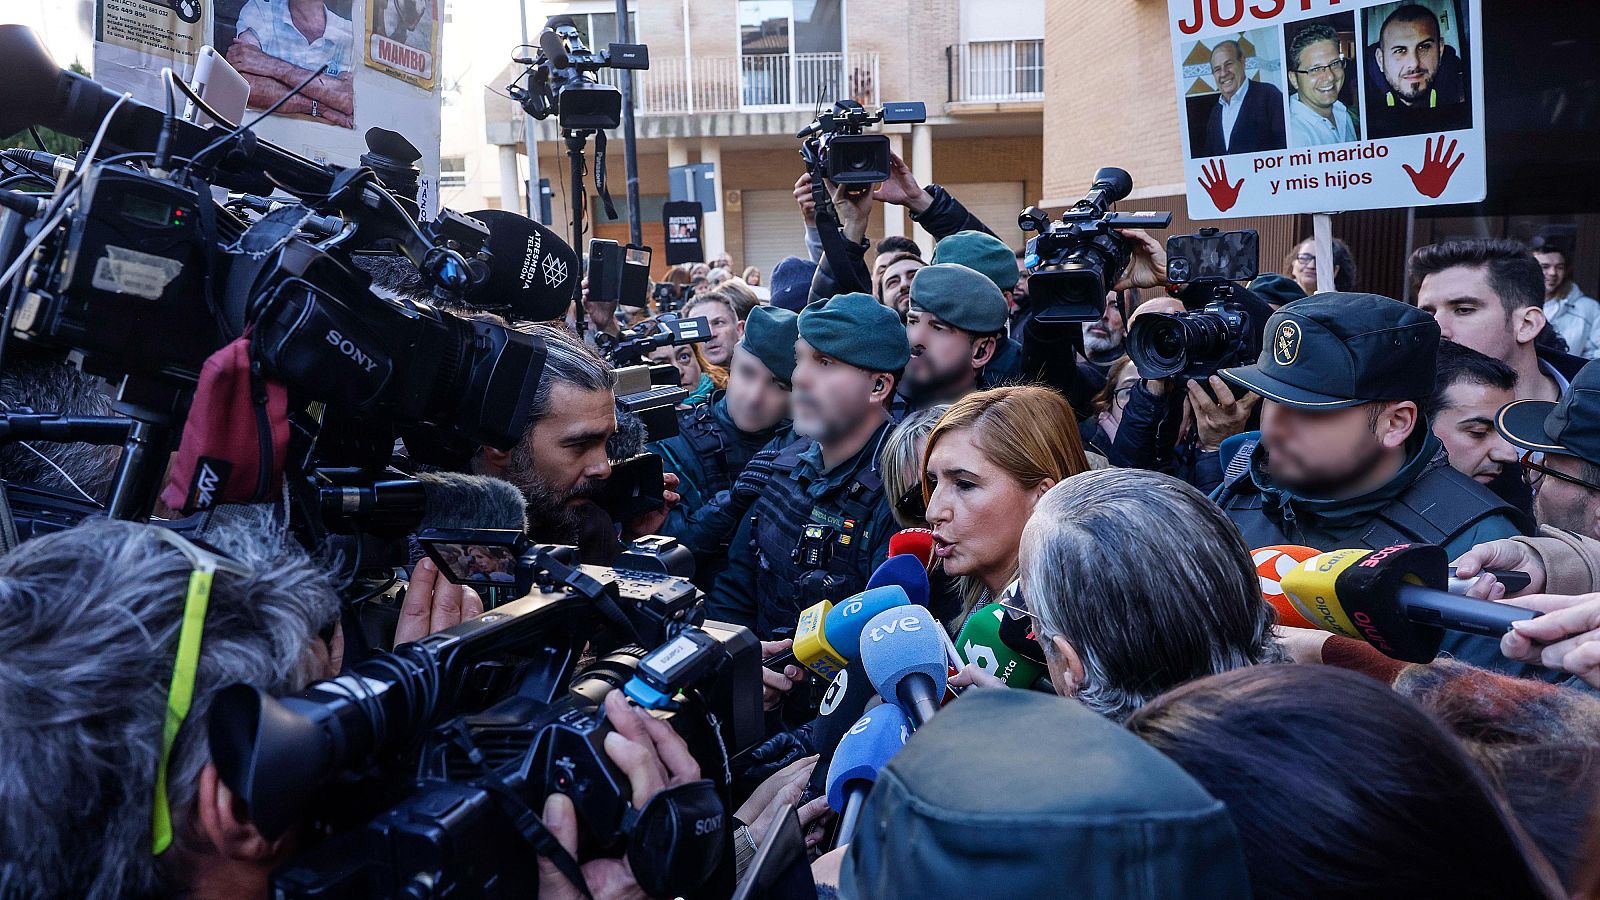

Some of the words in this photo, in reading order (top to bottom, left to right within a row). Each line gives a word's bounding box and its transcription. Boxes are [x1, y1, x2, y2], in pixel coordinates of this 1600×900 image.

[134, 10, 147, 19] 896
[378, 39, 426, 73] MAMBO
[1253, 155, 1284, 173] por
[1289, 149, 1312, 166] mi
[1318, 142, 1389, 164] marido
[1270, 180, 1280, 195] y
[1286, 174, 1319, 190] mis
[1325, 170, 1373, 189] hijos
[519, 235, 534, 280] TELEVISIÓN
[522, 229, 542, 290] ATRESMEDIA
[325, 329, 378, 373] SONY
[869, 616, 922, 642] tve
